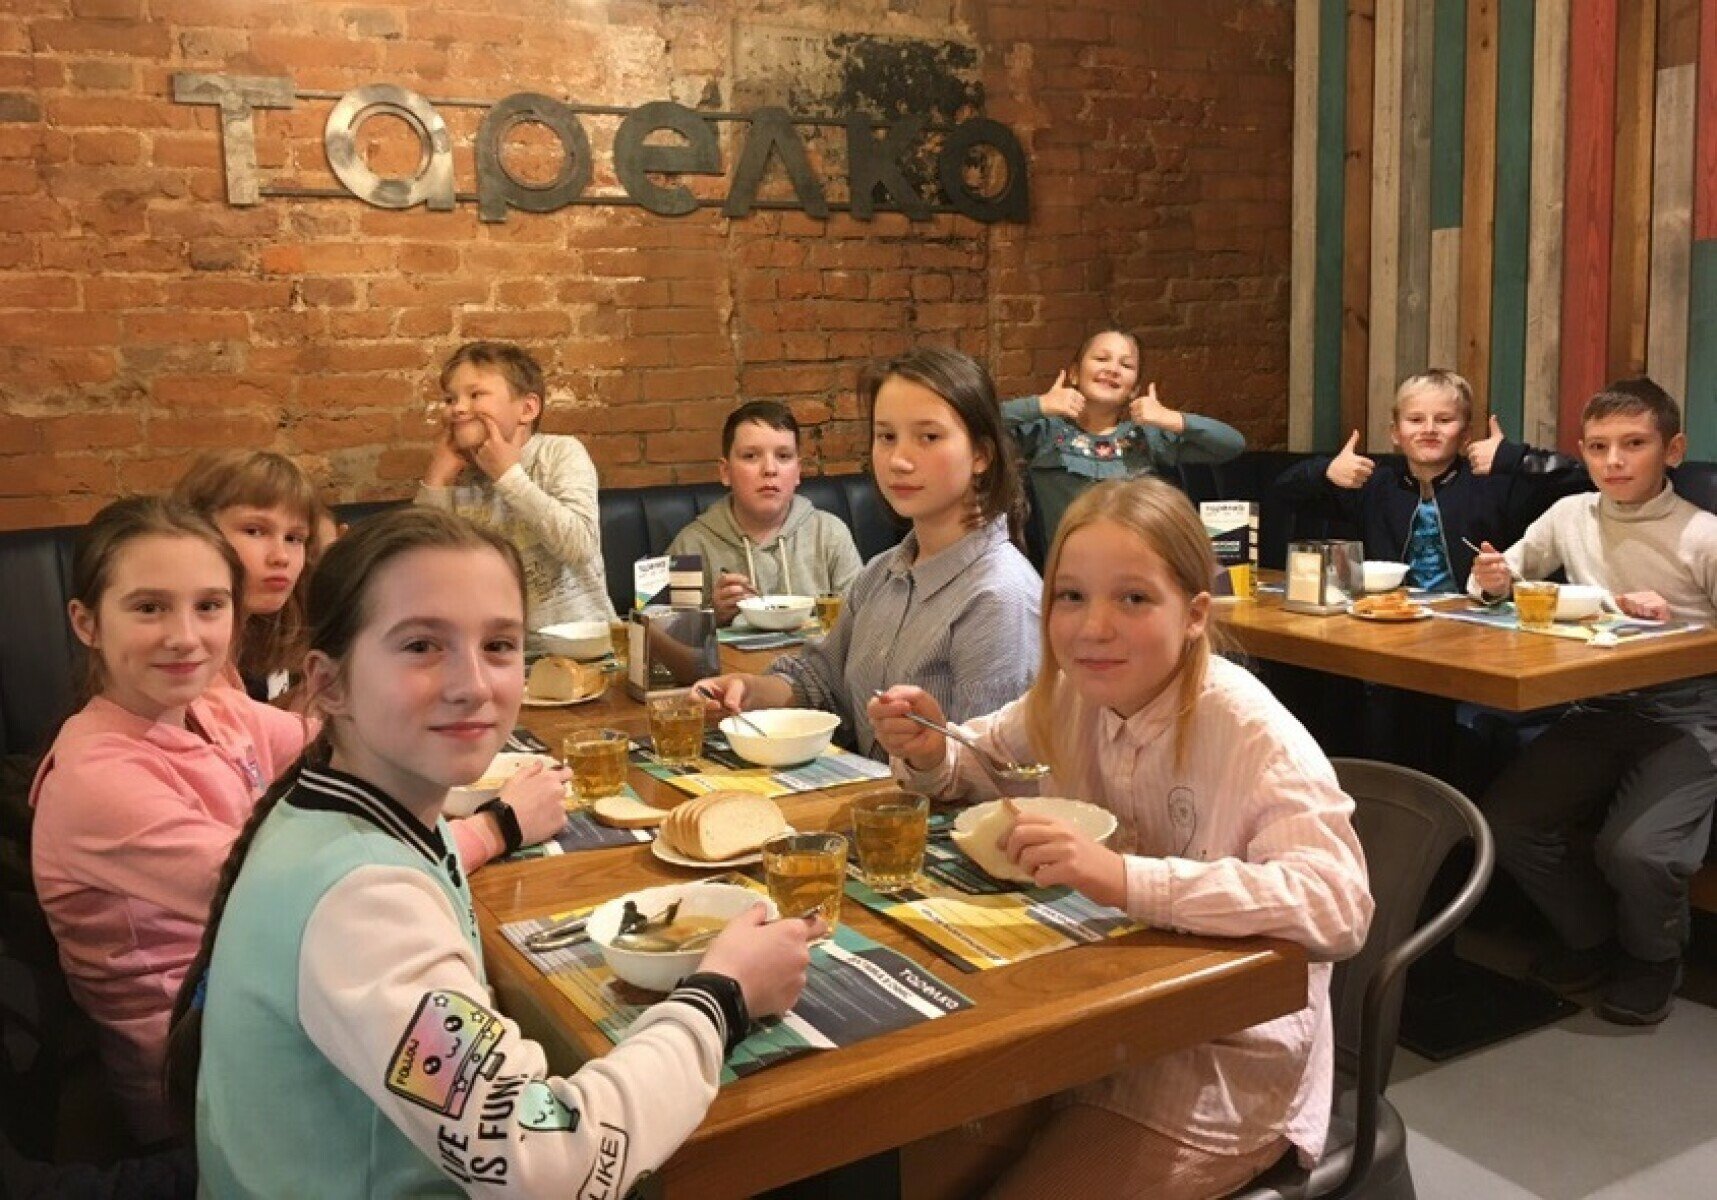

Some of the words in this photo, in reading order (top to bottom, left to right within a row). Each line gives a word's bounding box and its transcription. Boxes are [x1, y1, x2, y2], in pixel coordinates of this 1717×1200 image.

[478, 1074, 529, 1139] FUN!
[470, 1155, 507, 1186] IS
[588, 1137, 619, 1200] LIKE
